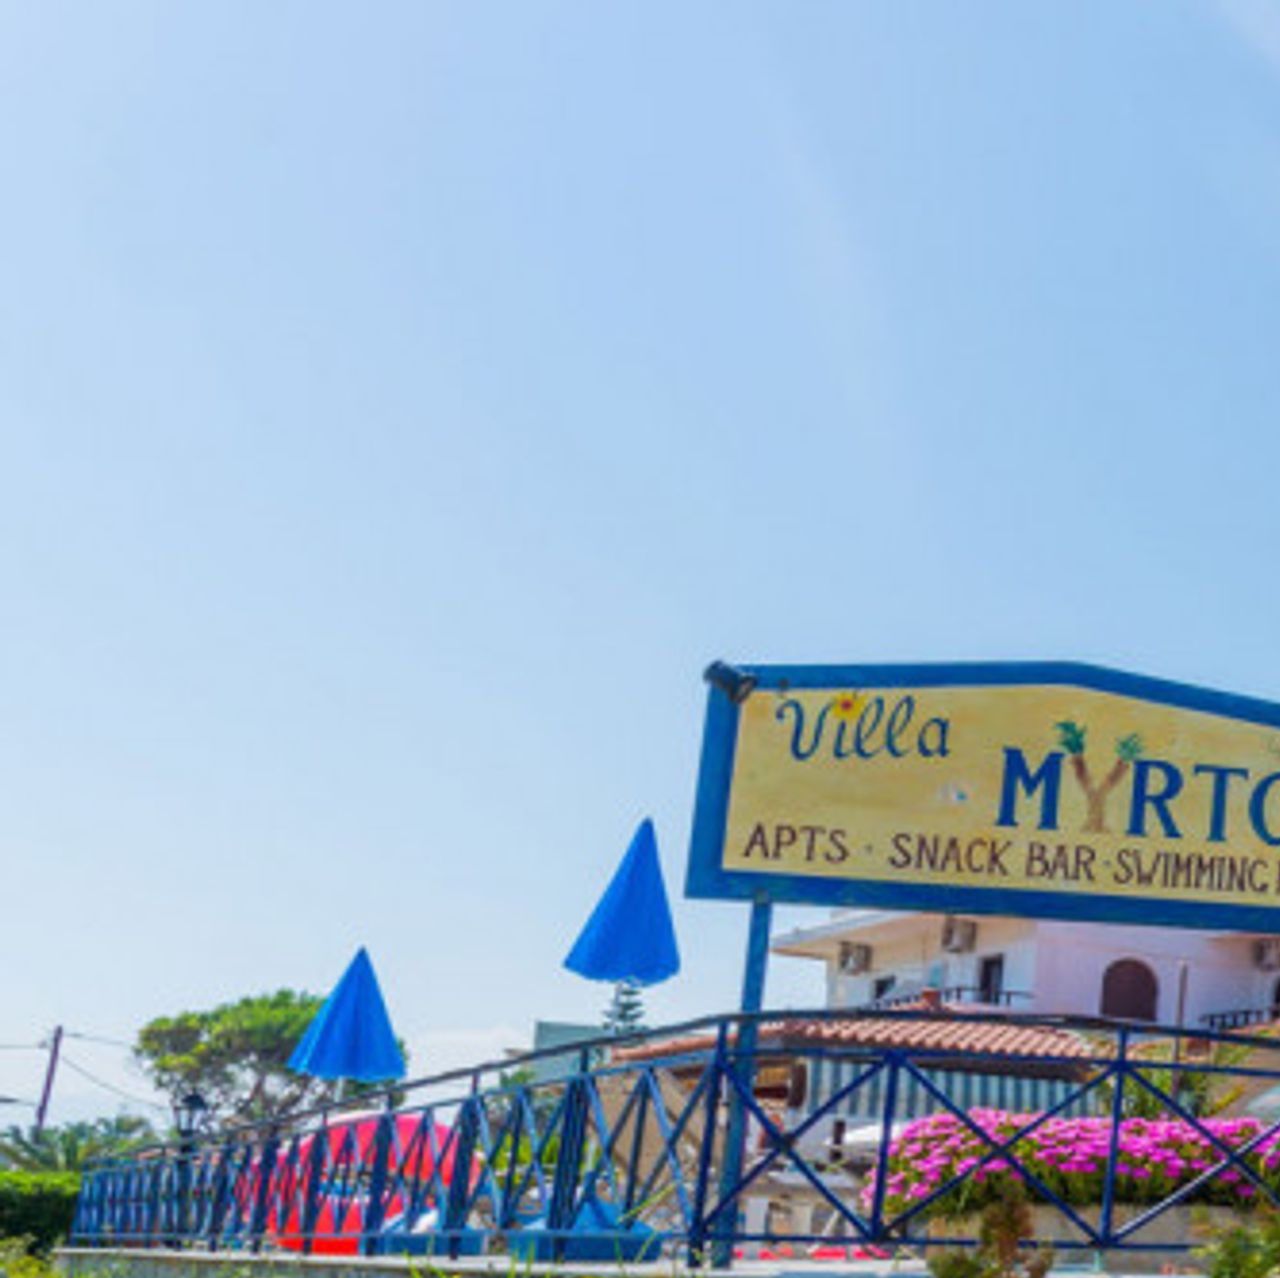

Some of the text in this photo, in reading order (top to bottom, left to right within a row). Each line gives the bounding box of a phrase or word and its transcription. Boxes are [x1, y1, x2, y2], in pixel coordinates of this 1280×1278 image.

[775, 694, 951, 761] Villa
[743, 821, 850, 863] APTS
[887, 832, 1013, 877] SNACK
[1025, 840, 1096, 882] BAR
[1113, 849, 1269, 893] SWIMMING
